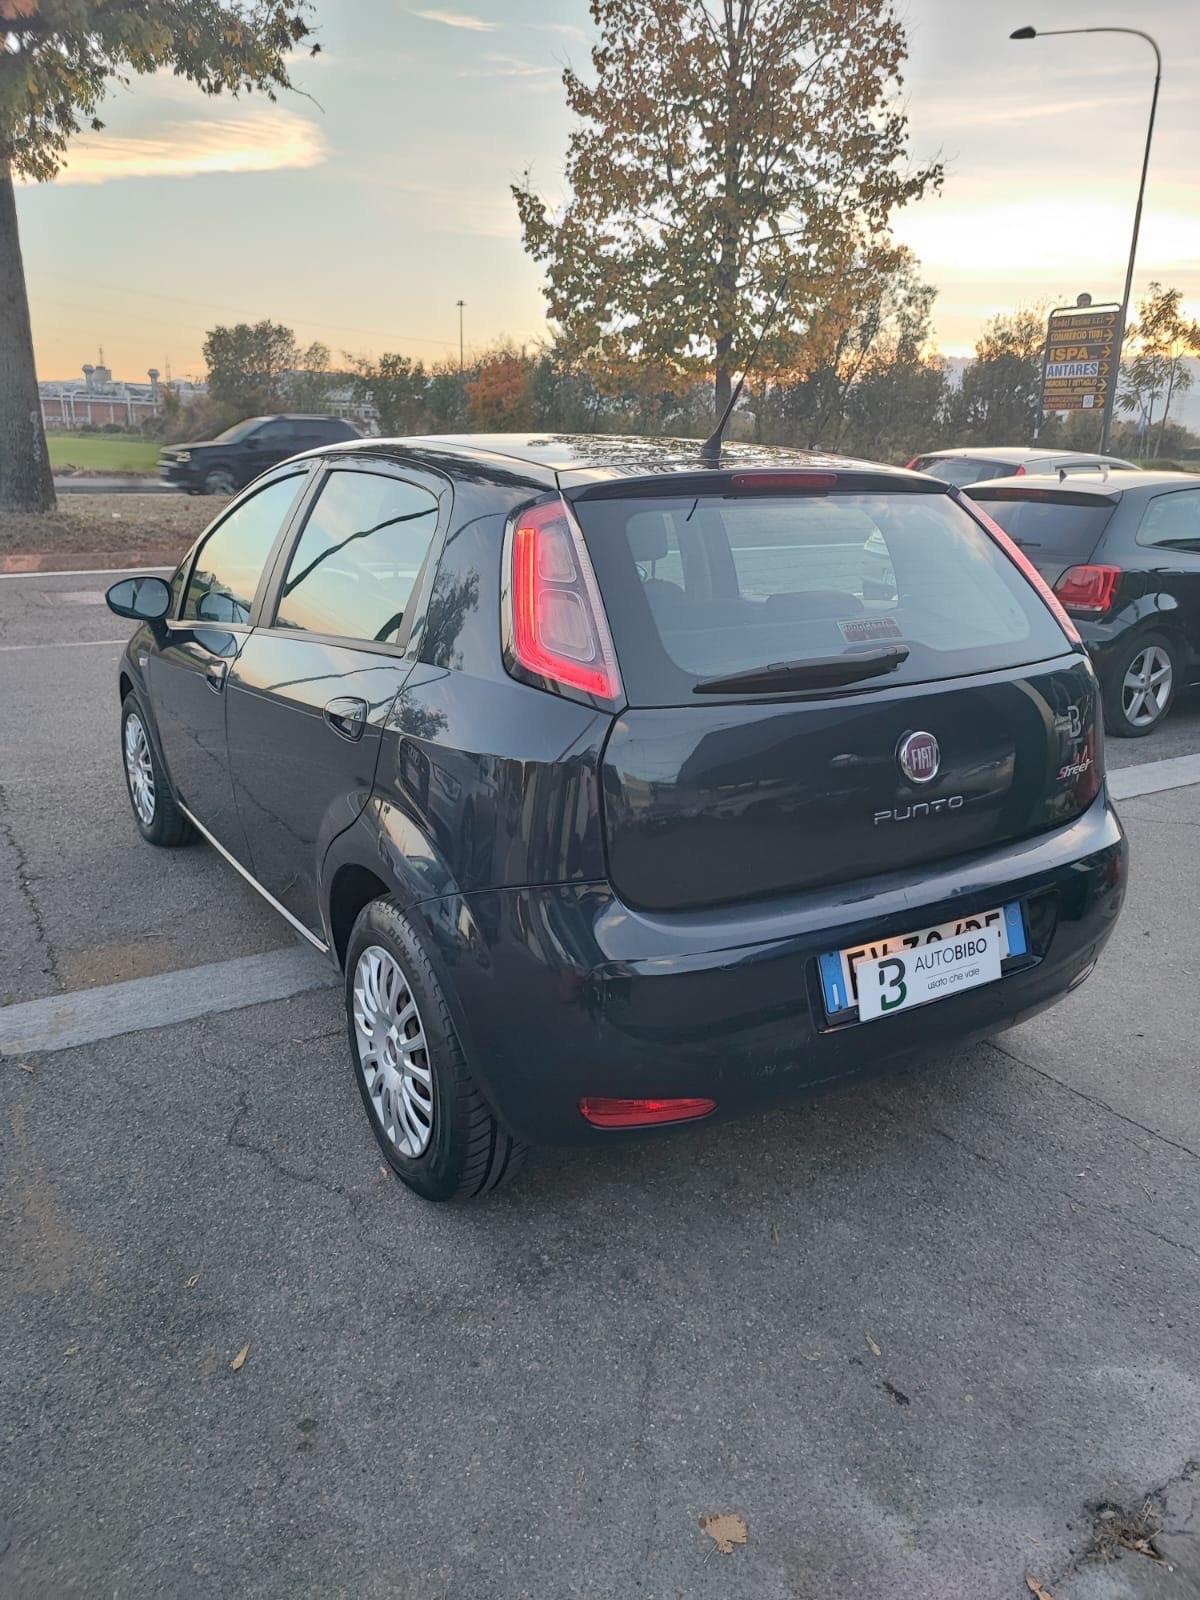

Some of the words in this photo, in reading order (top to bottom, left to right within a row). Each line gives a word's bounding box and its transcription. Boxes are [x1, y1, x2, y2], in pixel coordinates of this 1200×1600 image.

[1049, 347, 1089, 361] ISPA
[1047, 362, 1098, 377] ANTARES
[911, 745, 932, 770] FIAT
[1056, 758, 1093, 780] Street
[874, 795, 964, 824] PUNTO
[914, 937, 987, 973] AUTOBIBO
[927, 977, 947, 990] usato
[949, 972, 964, 985] che
[964, 967, 980, 981] vale
